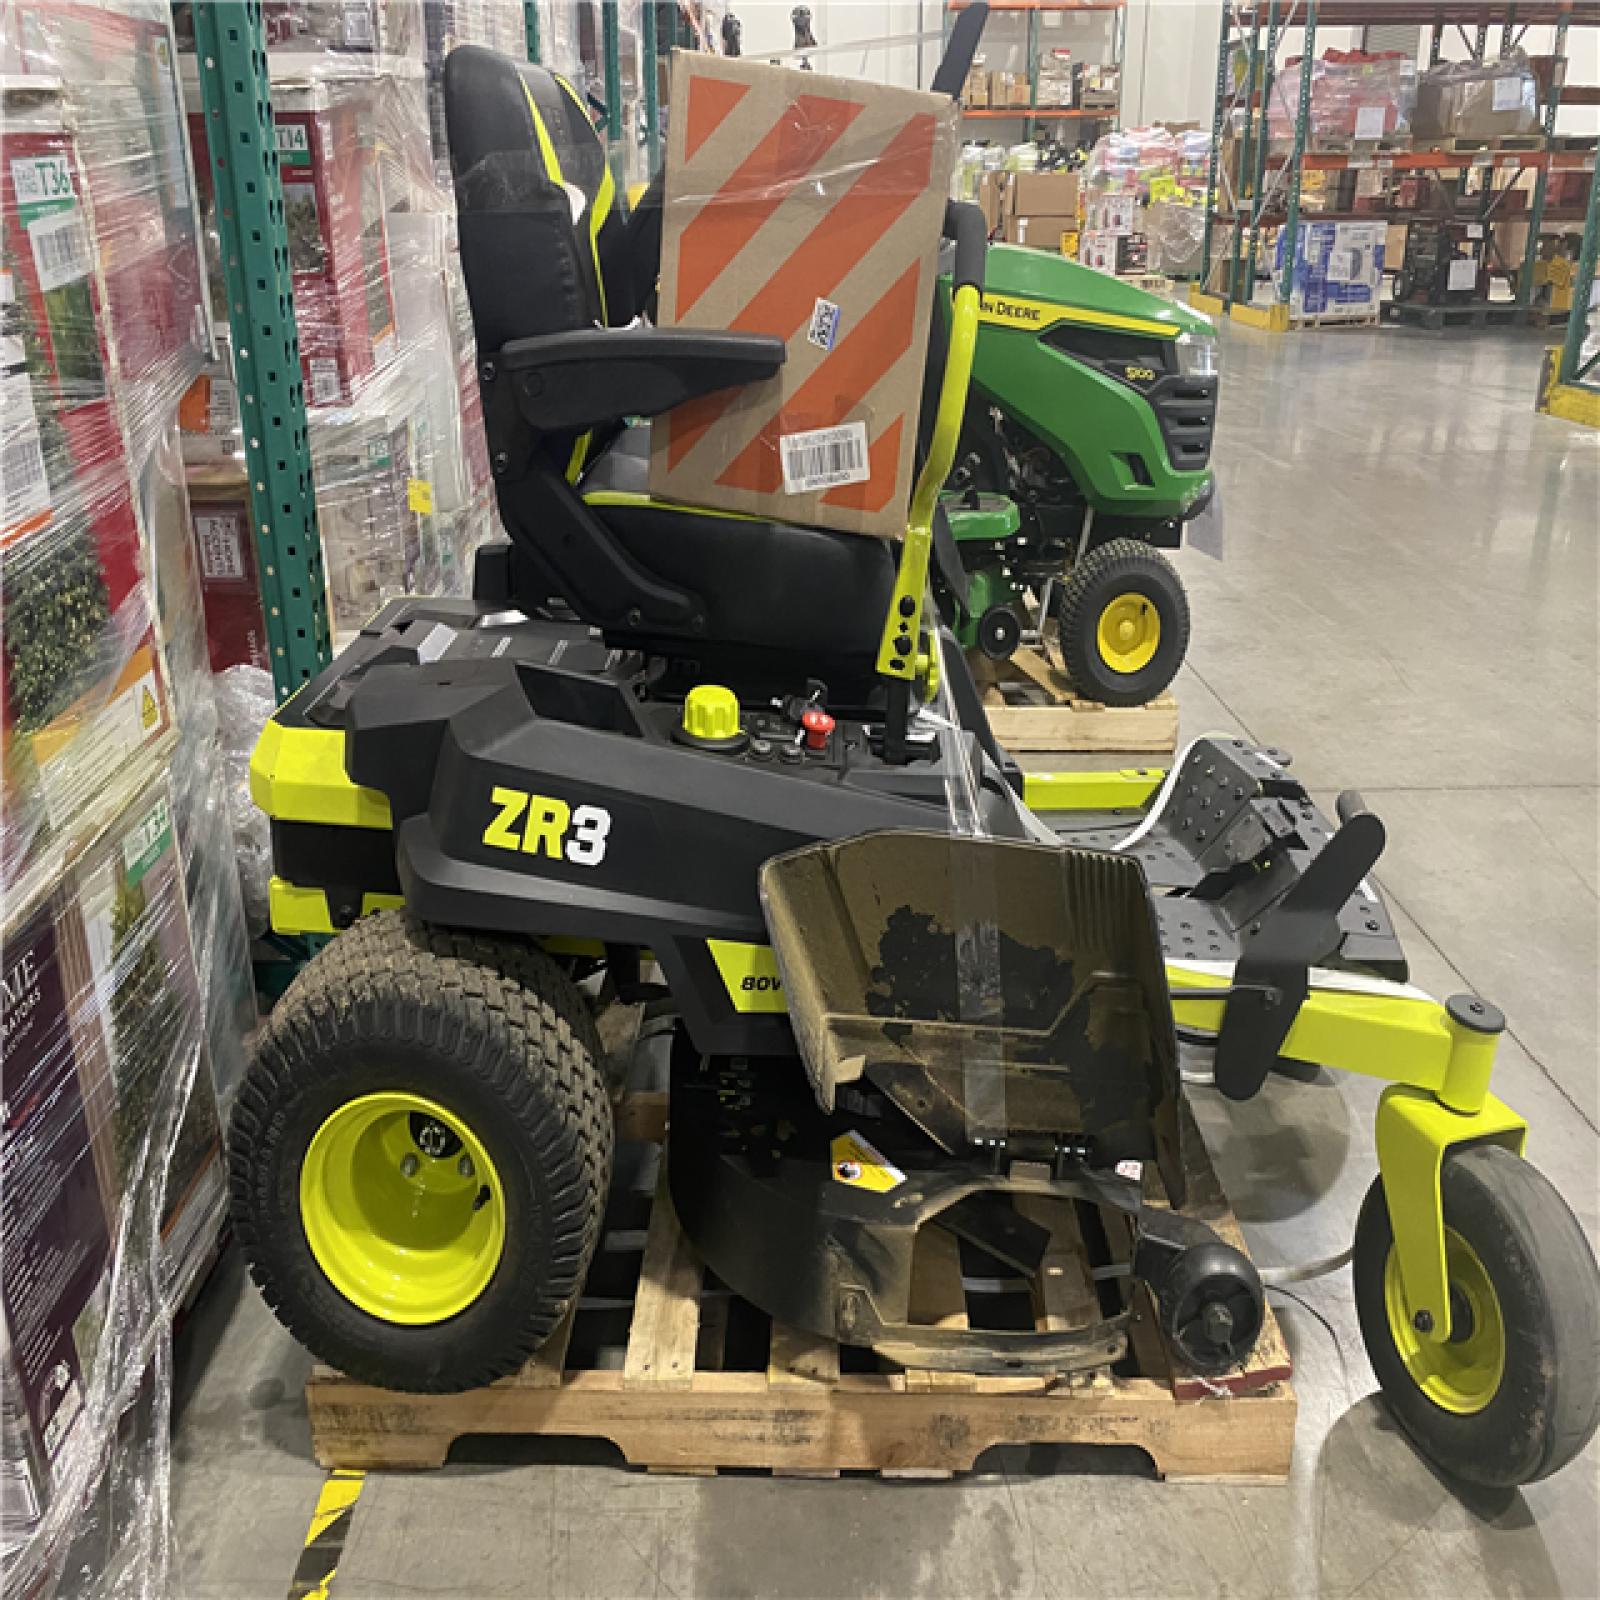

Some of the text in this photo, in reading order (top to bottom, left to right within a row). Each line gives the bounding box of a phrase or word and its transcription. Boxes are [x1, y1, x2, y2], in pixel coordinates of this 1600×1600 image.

[275, 127, 303, 148] T14
[996, 301, 1041, 320] DEERE
[482, 785, 612, 866] ZR3
